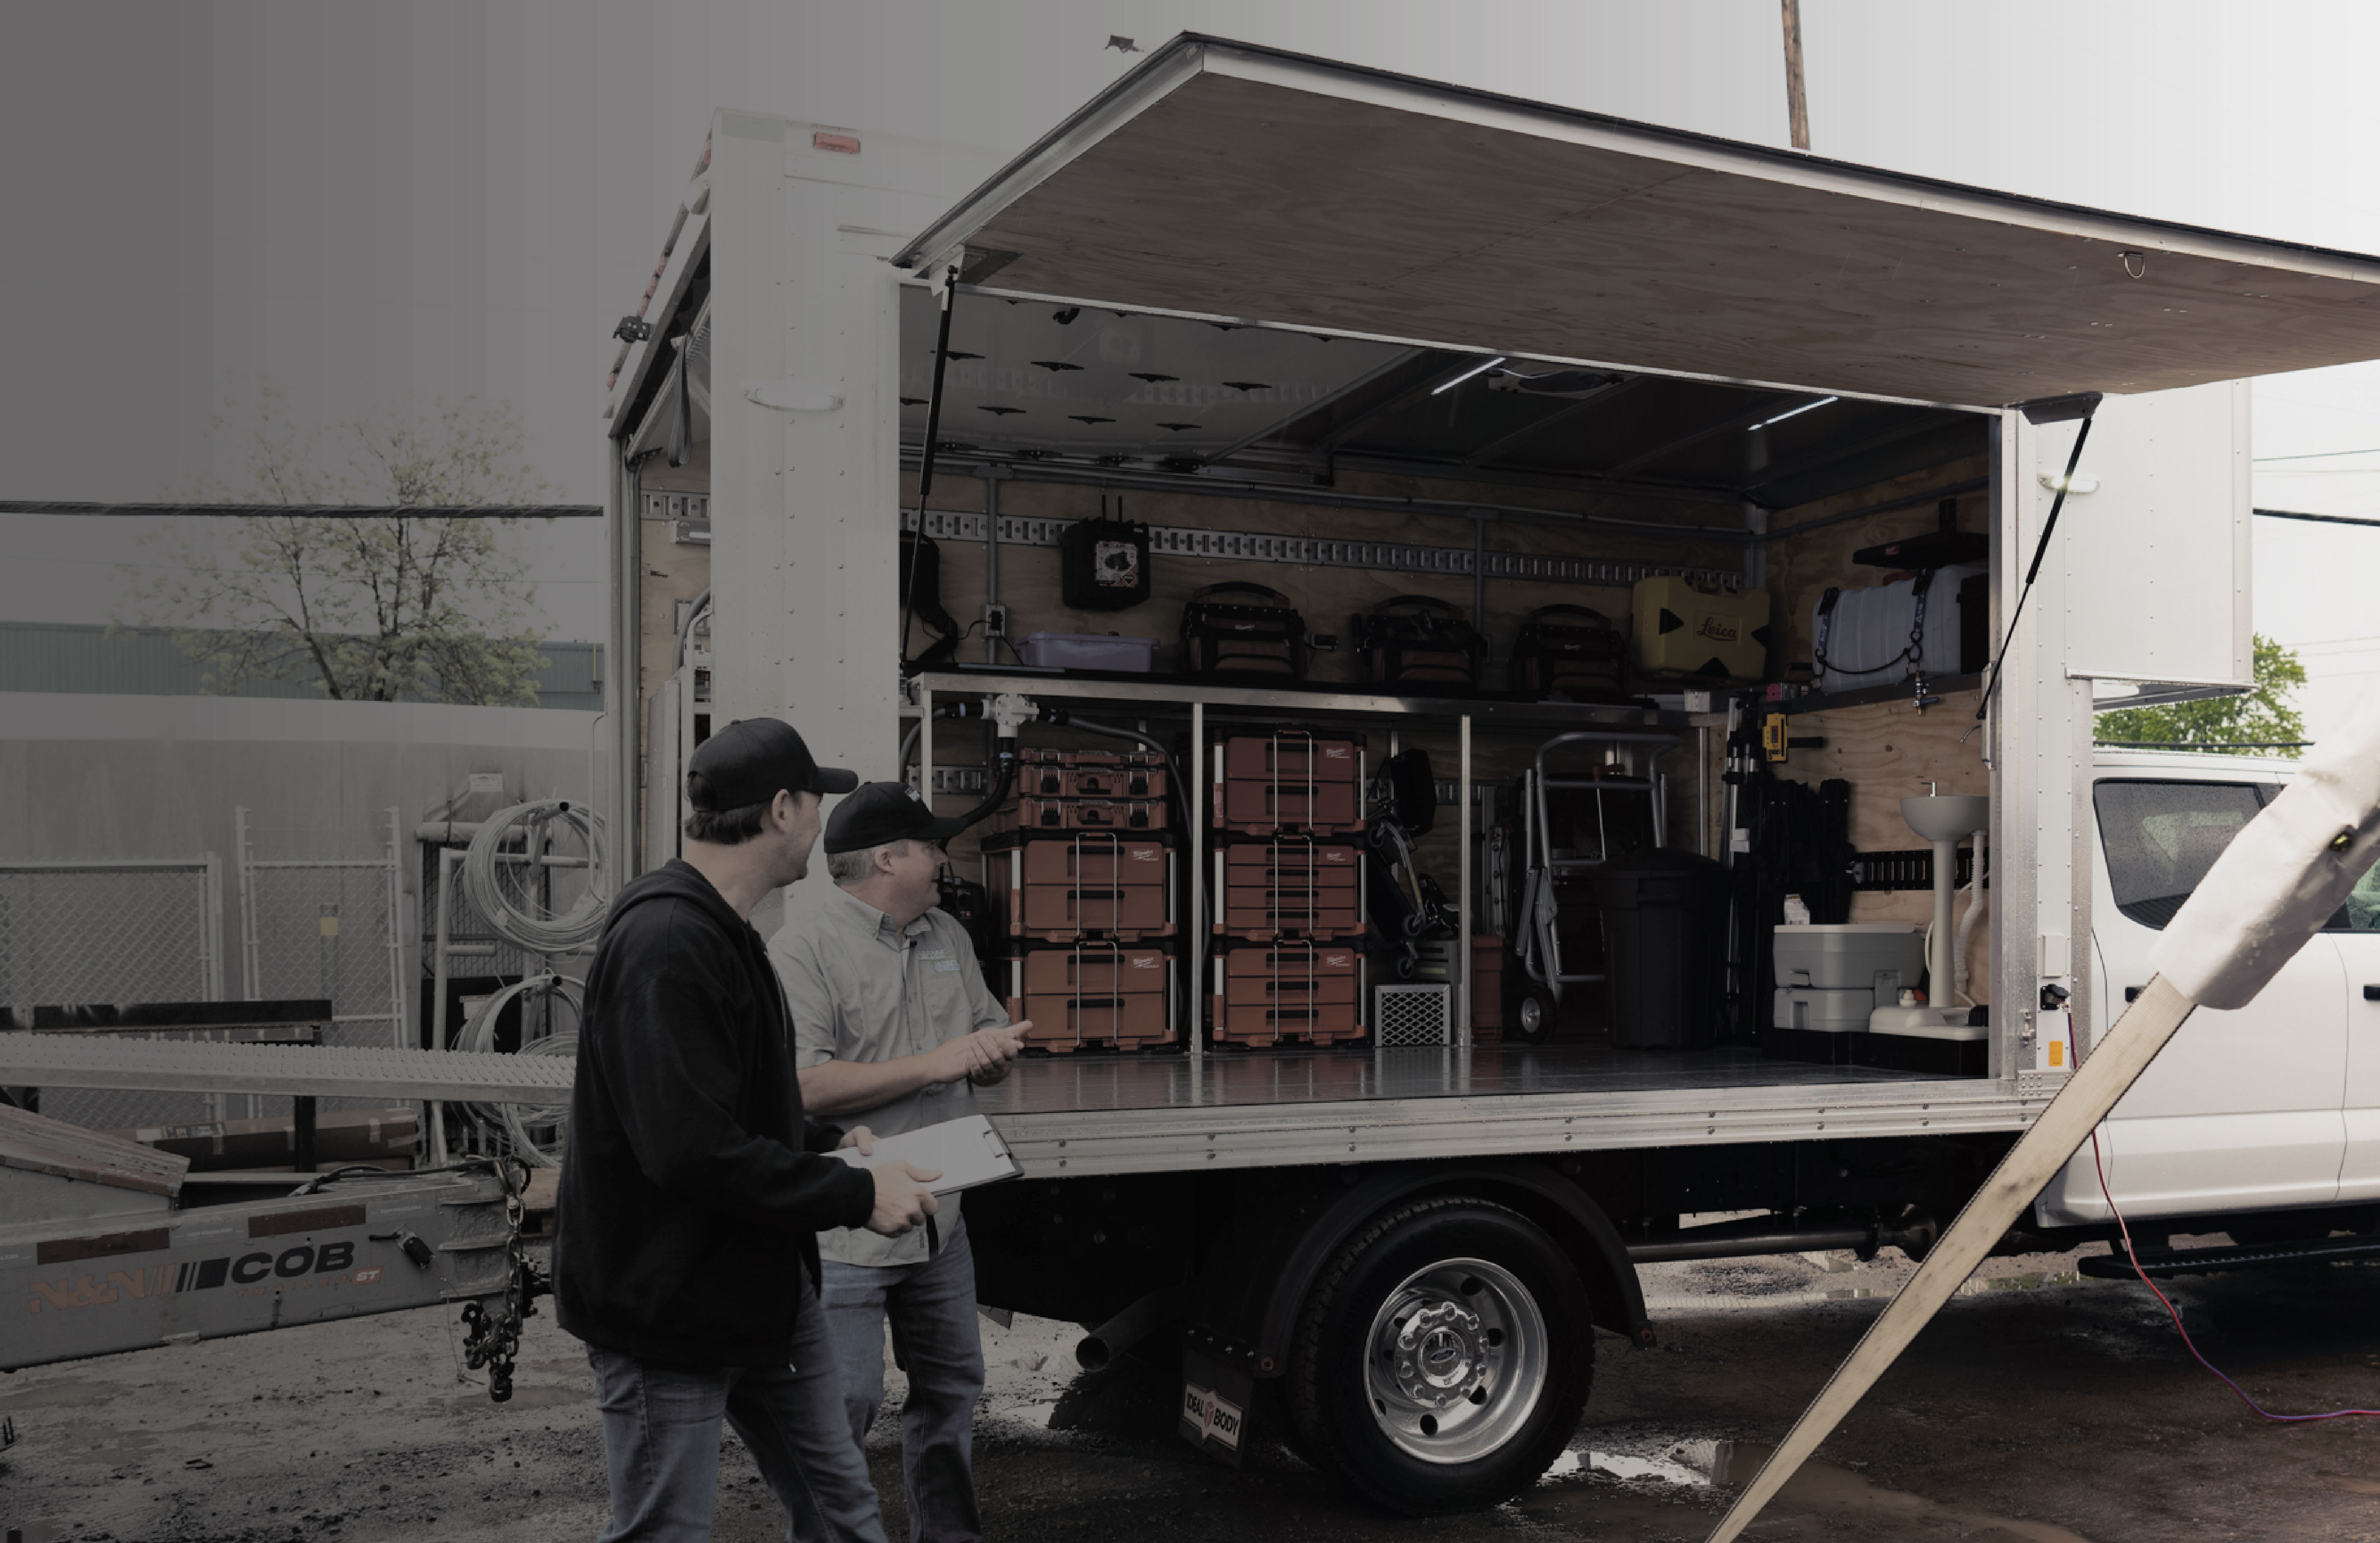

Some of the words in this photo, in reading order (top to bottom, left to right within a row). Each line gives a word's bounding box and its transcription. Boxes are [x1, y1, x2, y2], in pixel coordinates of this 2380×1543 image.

[1696, 616, 1737, 641] Leica
[231, 1241, 355, 1284] COB
[355, 1270, 380, 1281] ST
[1186, 1392, 1204, 1418] IDEAL
[1213, 1408, 1239, 1436] BODY
